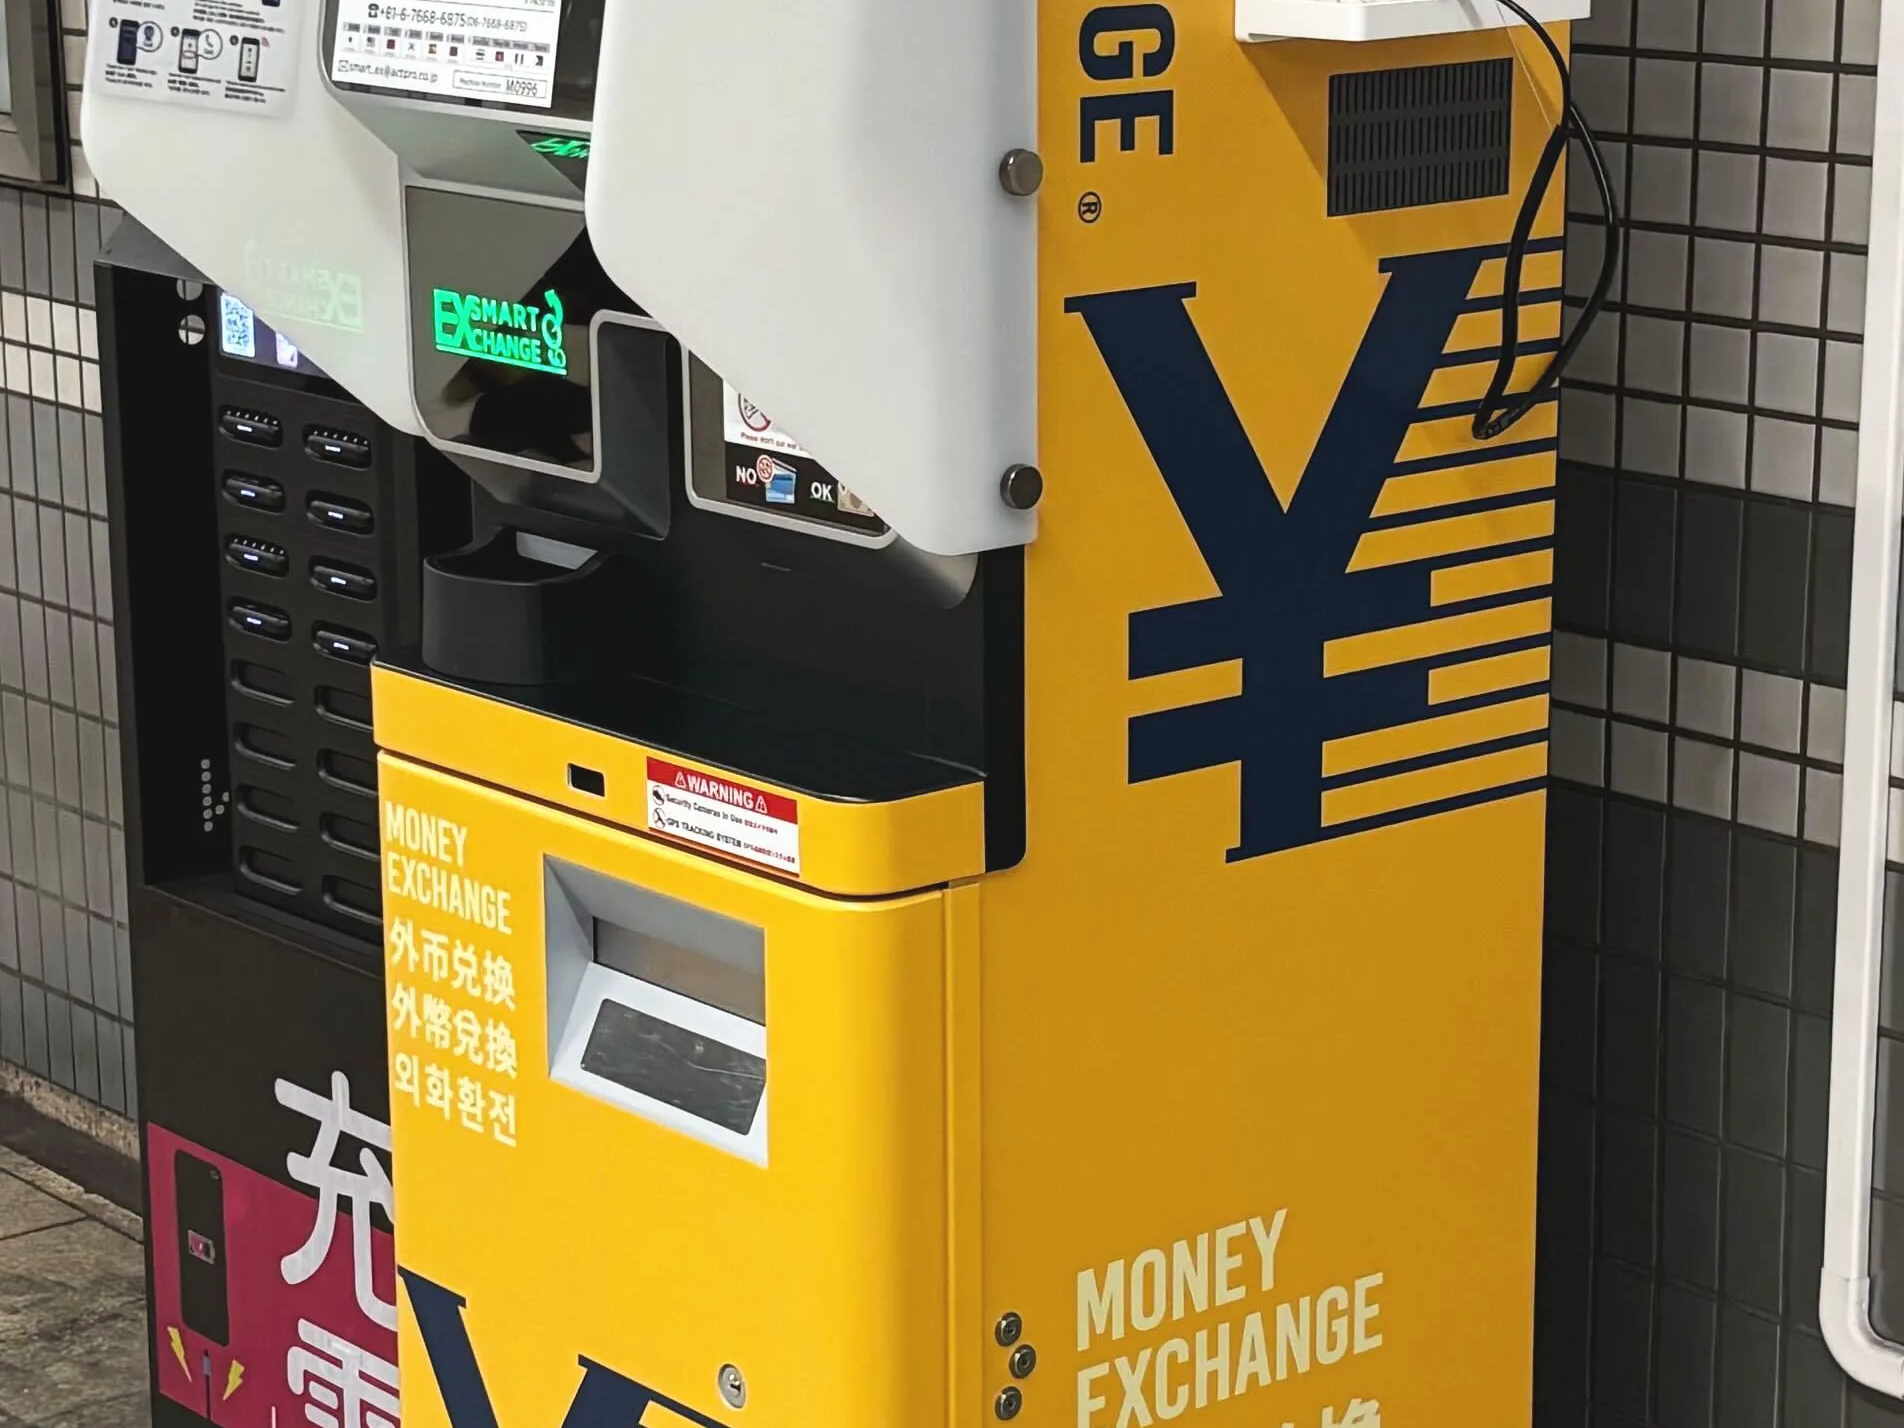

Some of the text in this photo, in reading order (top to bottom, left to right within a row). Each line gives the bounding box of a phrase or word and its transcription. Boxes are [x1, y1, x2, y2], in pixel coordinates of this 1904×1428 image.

[469, 294, 539, 332] SMART
[736, 465, 757, 485] NO
[811, 481, 833, 503] OK
[686, 774, 754, 809] WARNING
[385, 800, 467, 868] MONEY
[681, 821, 714, 839] TRACKING
[716, 832, 742, 848] SYSTEM
[386, 852, 512, 935] EXCHANGE
[390, 915, 517, 1012] 外币兑换
[395, 1051, 517, 1147] 외화환전
[1075, 1207, 1288, 1352] MONEY
